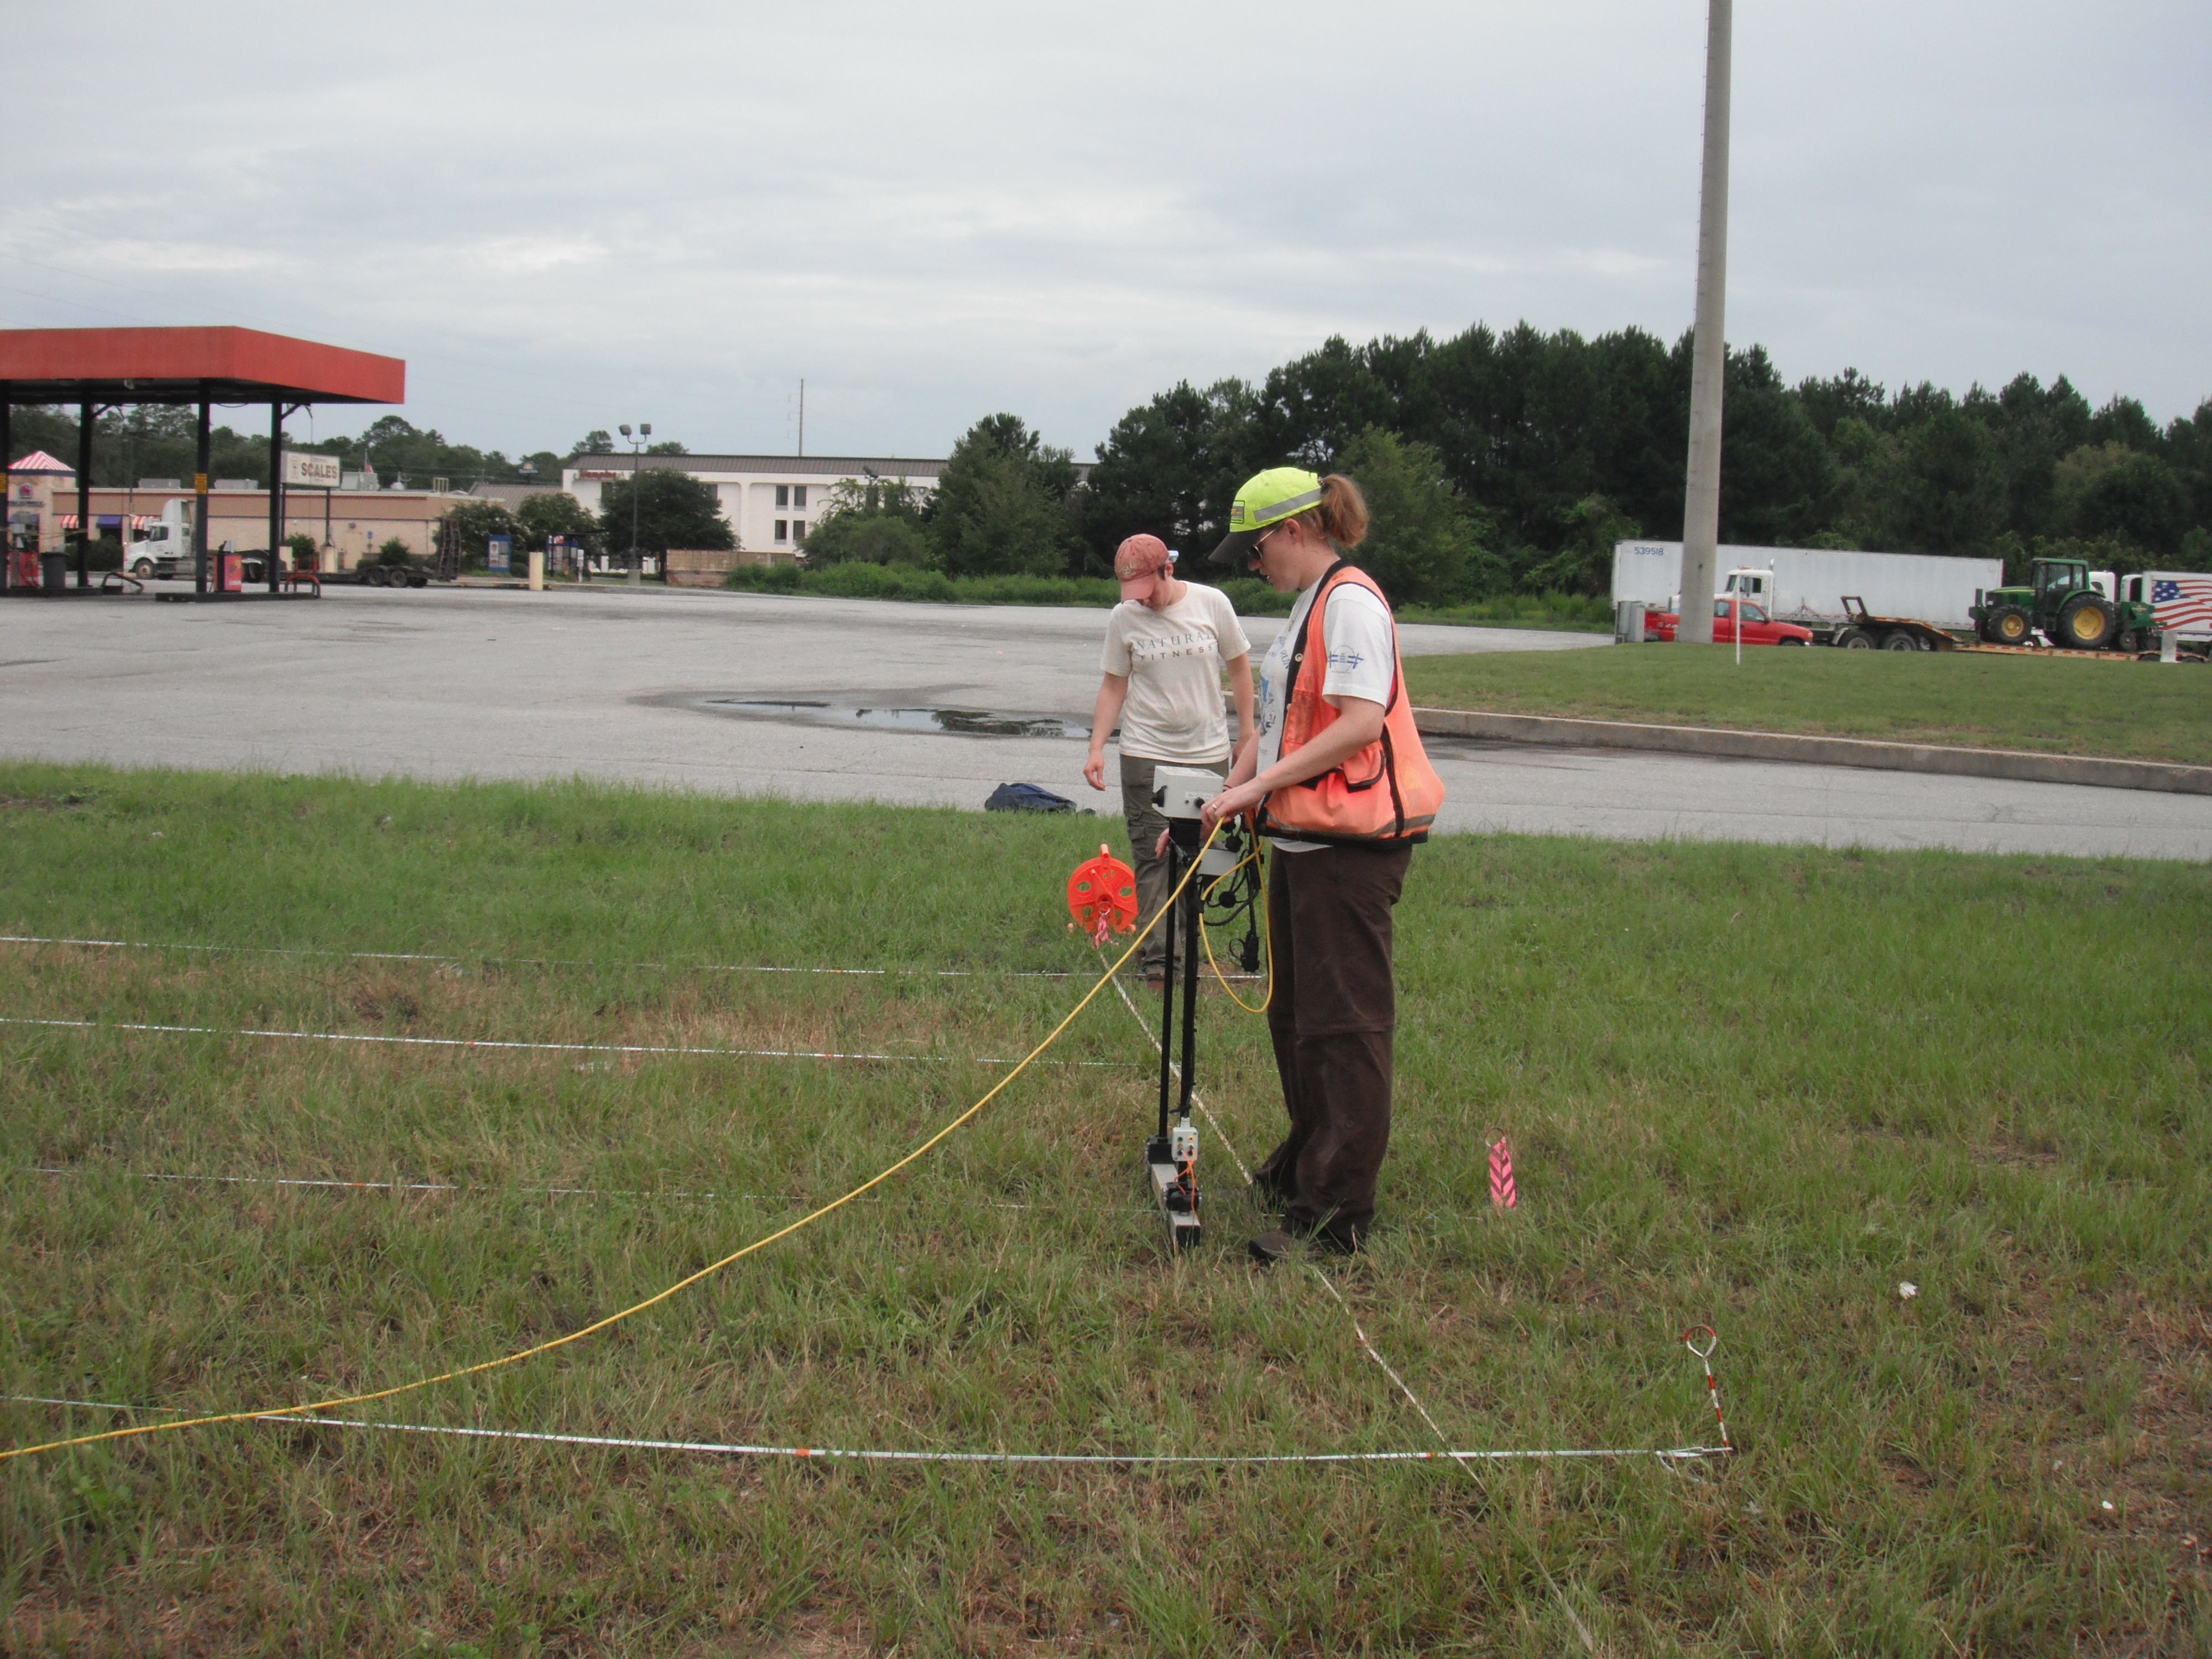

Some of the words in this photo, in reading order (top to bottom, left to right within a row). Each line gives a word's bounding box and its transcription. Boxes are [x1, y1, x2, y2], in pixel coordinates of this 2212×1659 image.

[301, 462, 338, 479] SCALES
[1634, 547, 1664, 556] 539518
[1136, 628, 1212, 650] NATURAL
[1140, 644, 1213, 661] FITNESS
